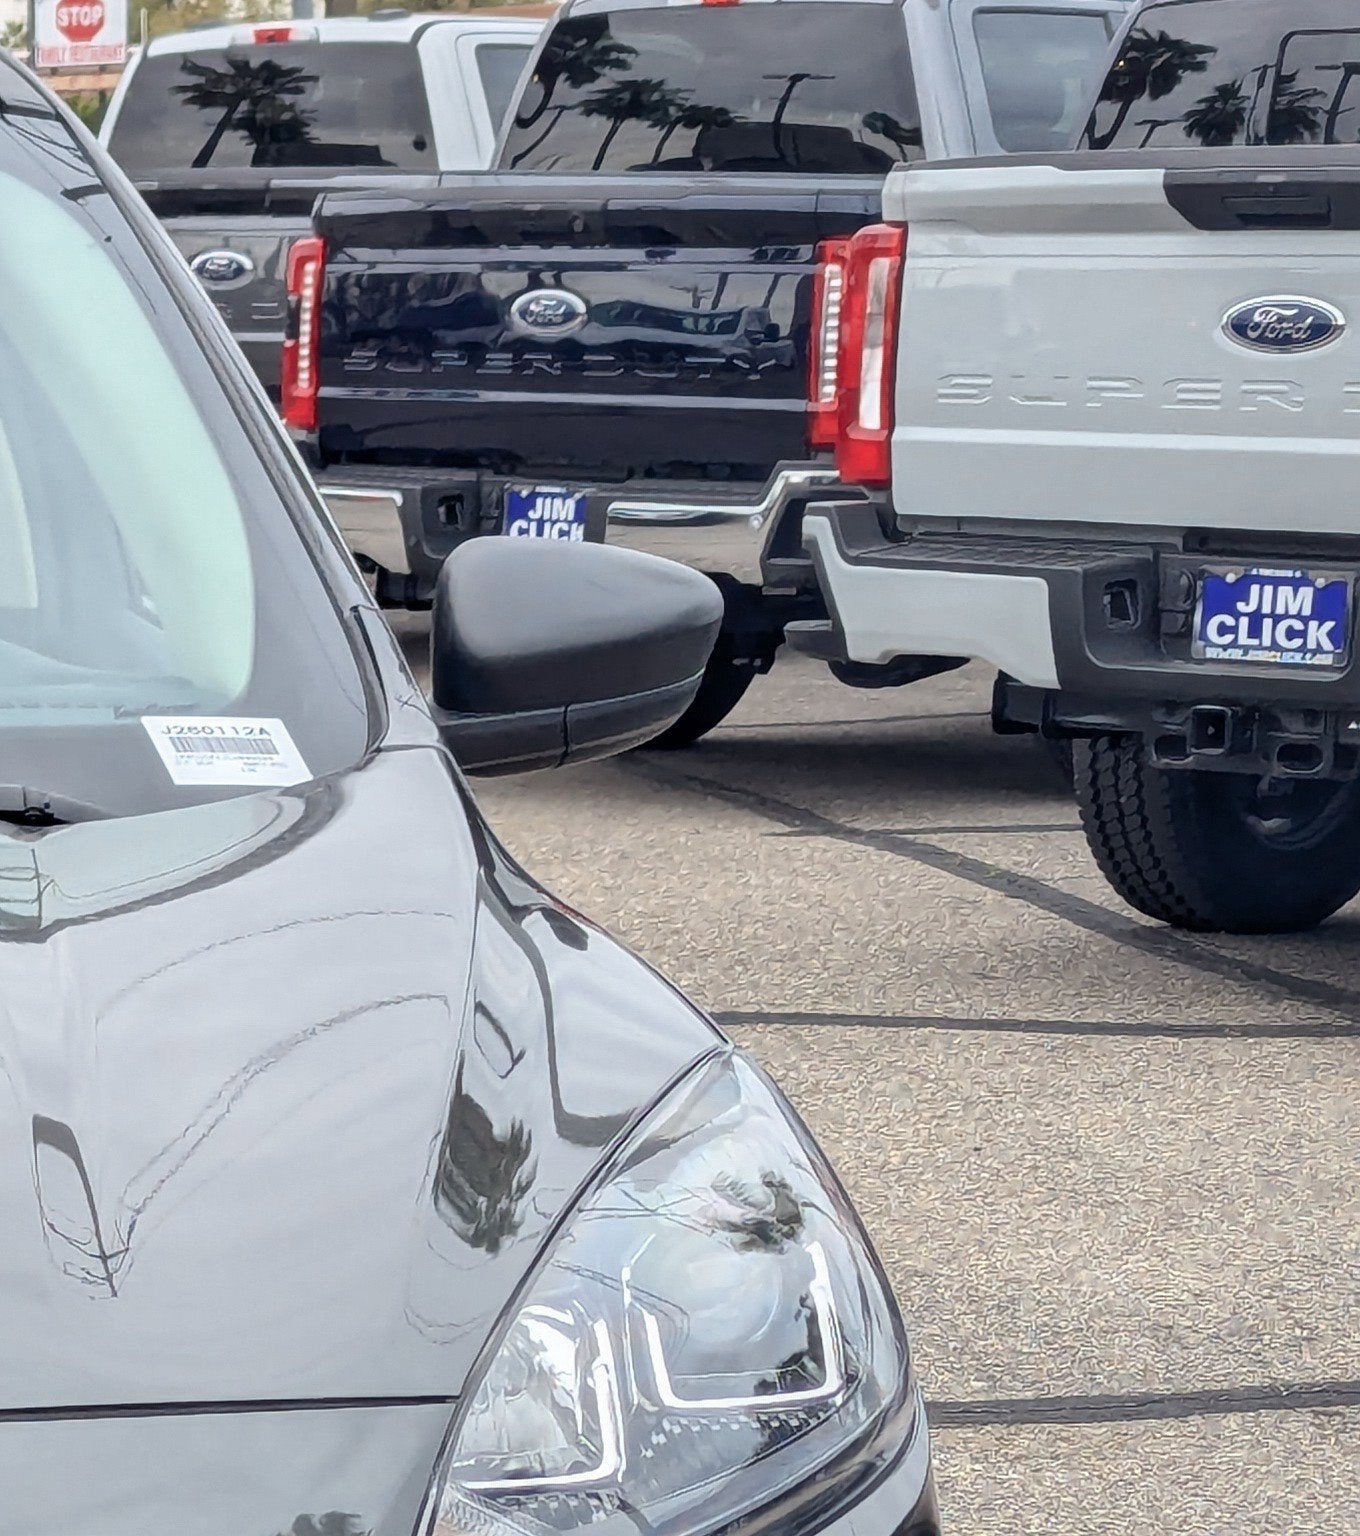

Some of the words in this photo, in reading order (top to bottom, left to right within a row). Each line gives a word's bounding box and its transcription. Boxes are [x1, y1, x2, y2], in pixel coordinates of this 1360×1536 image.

[57, 5, 103, 27] STOP
[525, 300, 567, 323] Ford
[1246, 306, 1315, 339] Ford
[342, 348, 564, 376] SUPER
[581, 353, 778, 381] DUTY
[936, 373, 1306, 413] SUPER
[527, 496, 576, 521] JIM
[1236, 583, 1314, 616] JIM
[1206, 613, 1337, 652] CLICK
